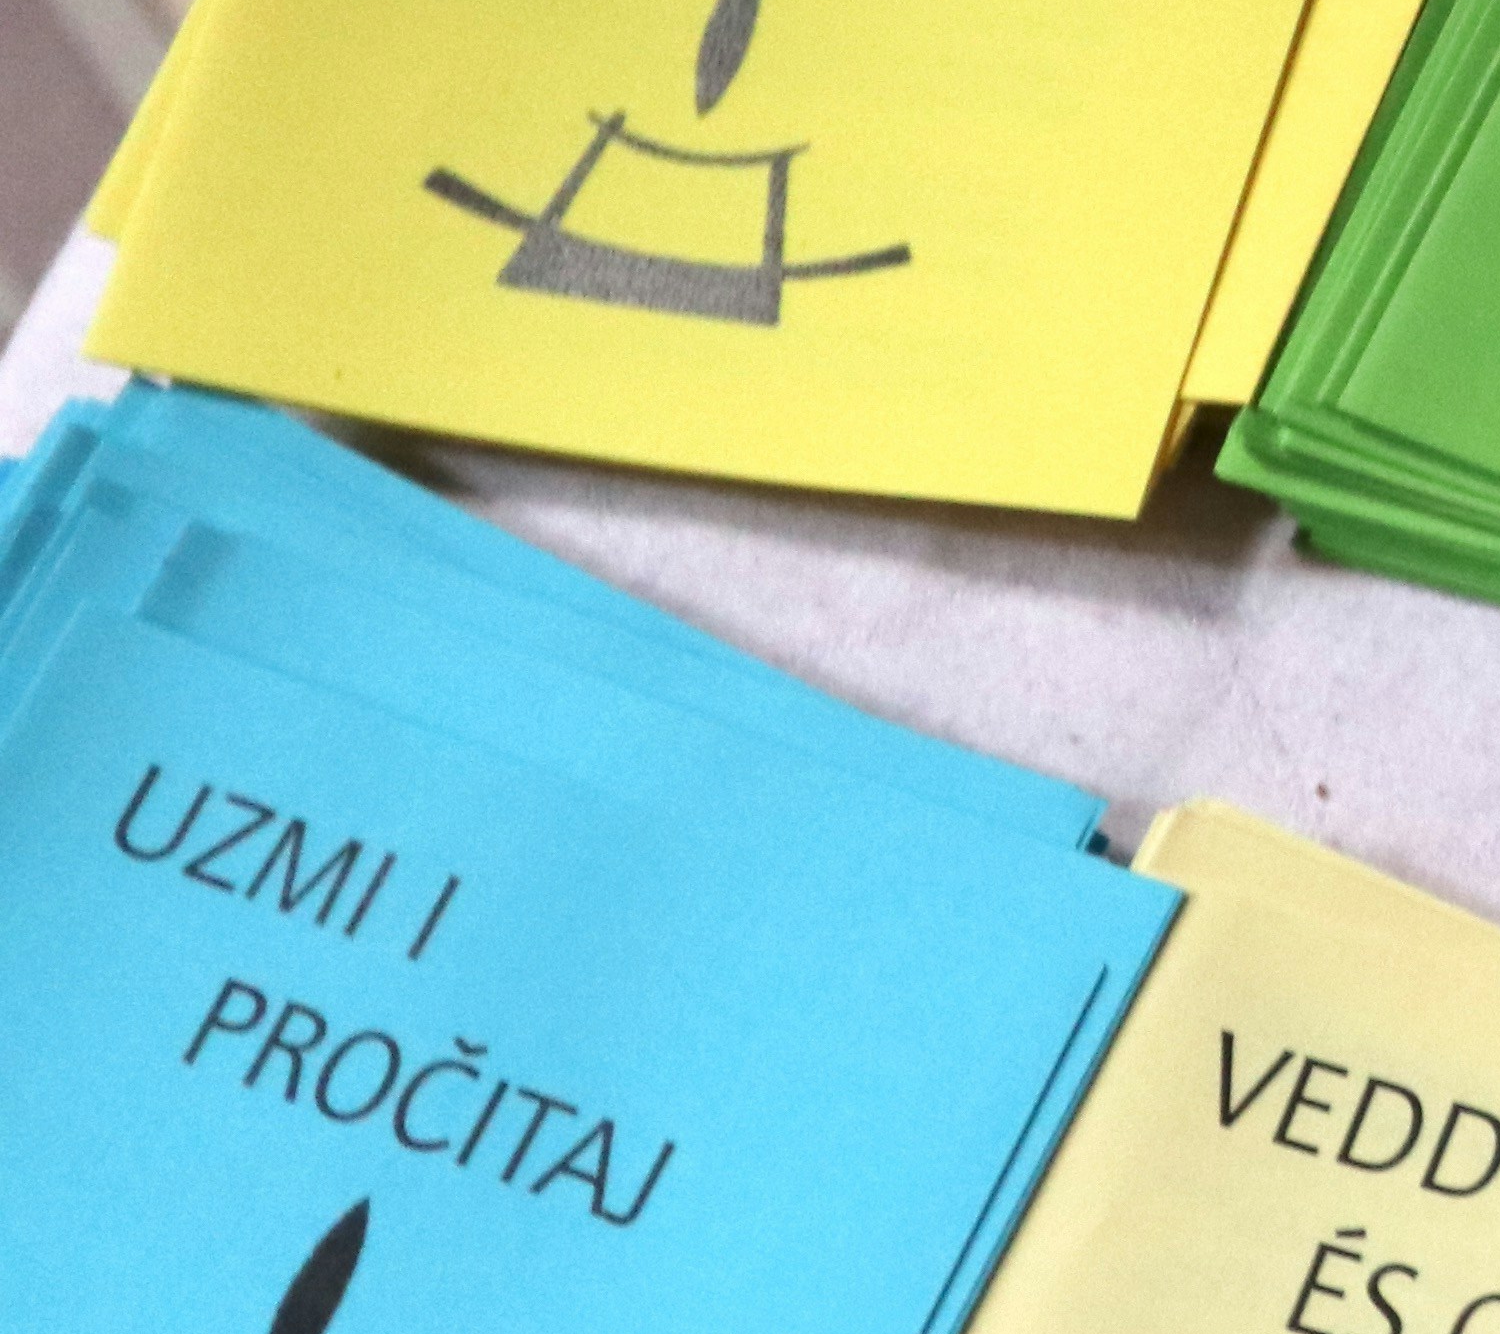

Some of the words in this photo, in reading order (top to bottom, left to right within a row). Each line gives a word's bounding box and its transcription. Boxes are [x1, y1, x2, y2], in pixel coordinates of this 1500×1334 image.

[114, 764, 393, 937] UZMI
[408, 875, 460, 960] I
[183, 978, 675, 1230] PROČITAJ
